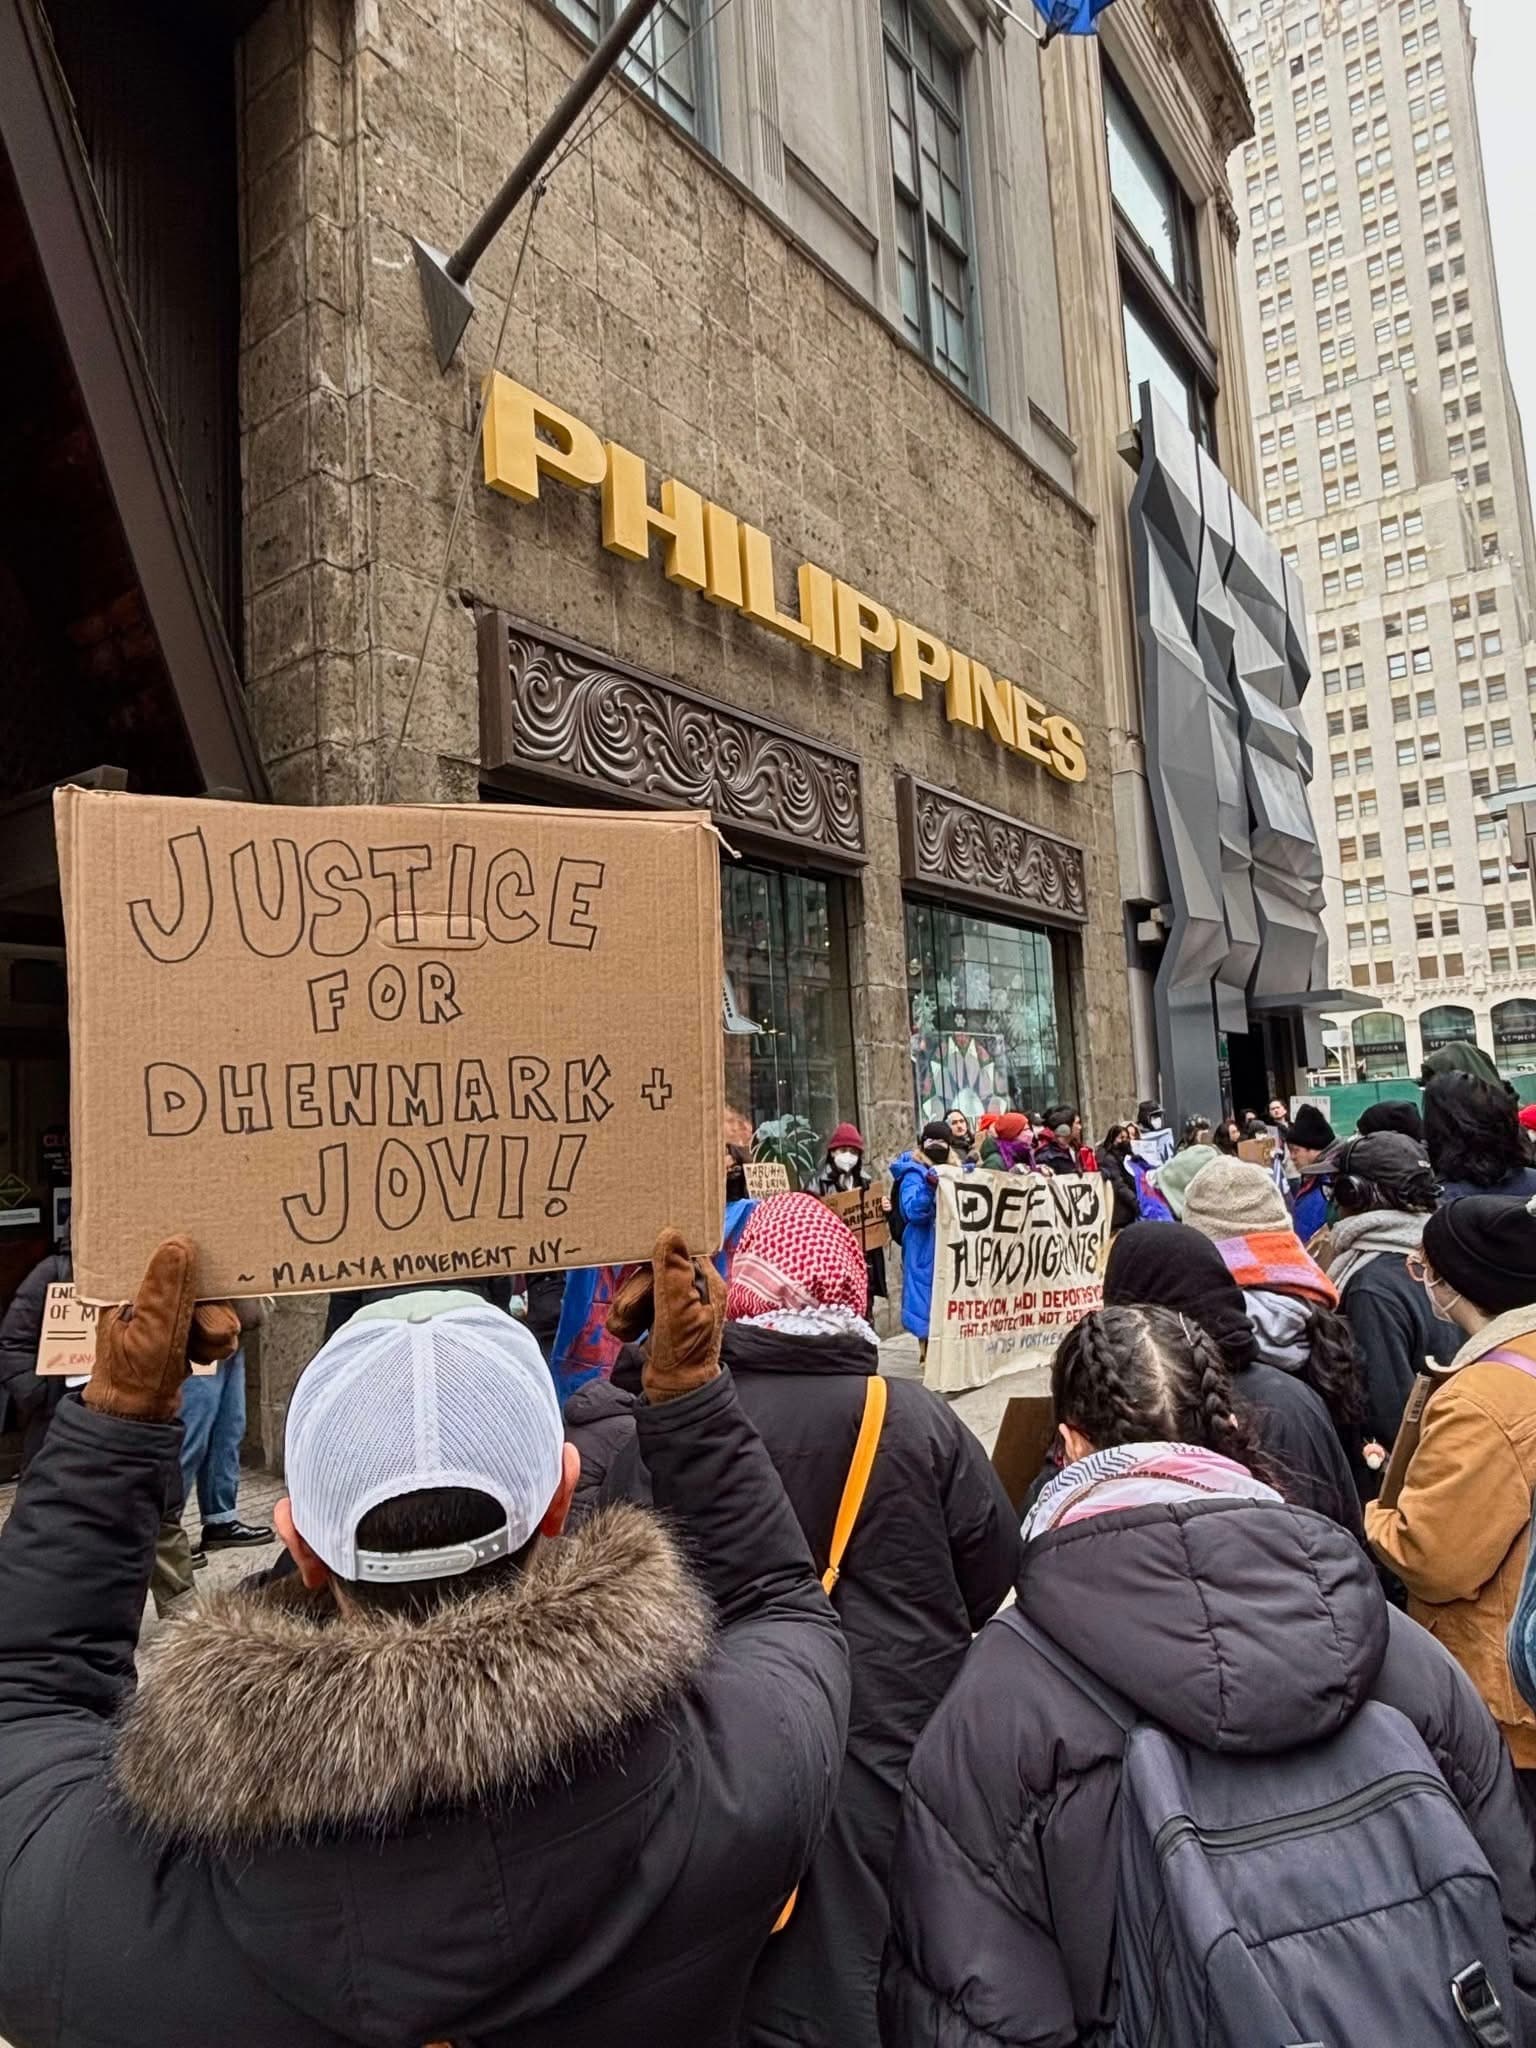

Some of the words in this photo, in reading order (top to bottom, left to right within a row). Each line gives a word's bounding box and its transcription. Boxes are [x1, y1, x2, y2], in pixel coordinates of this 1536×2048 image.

[482, 369, 1087, 783] PHILIPPINES
[127, 825, 606, 964] JUSTICE
[307, 961, 462, 1034] FOR
[1501, 1033, 1536, 1042] SEPHOR
[144, 1054, 615, 1137] DHENMARK
[282, 1133, 588, 1245] JOVI!
[272, 1256, 387, 1289] MALAYA
[393, 1245, 517, 1280] MOVEMENT
[50, 1304, 71, 1320] OF
[1039, 1311, 1061, 1325] NOT
